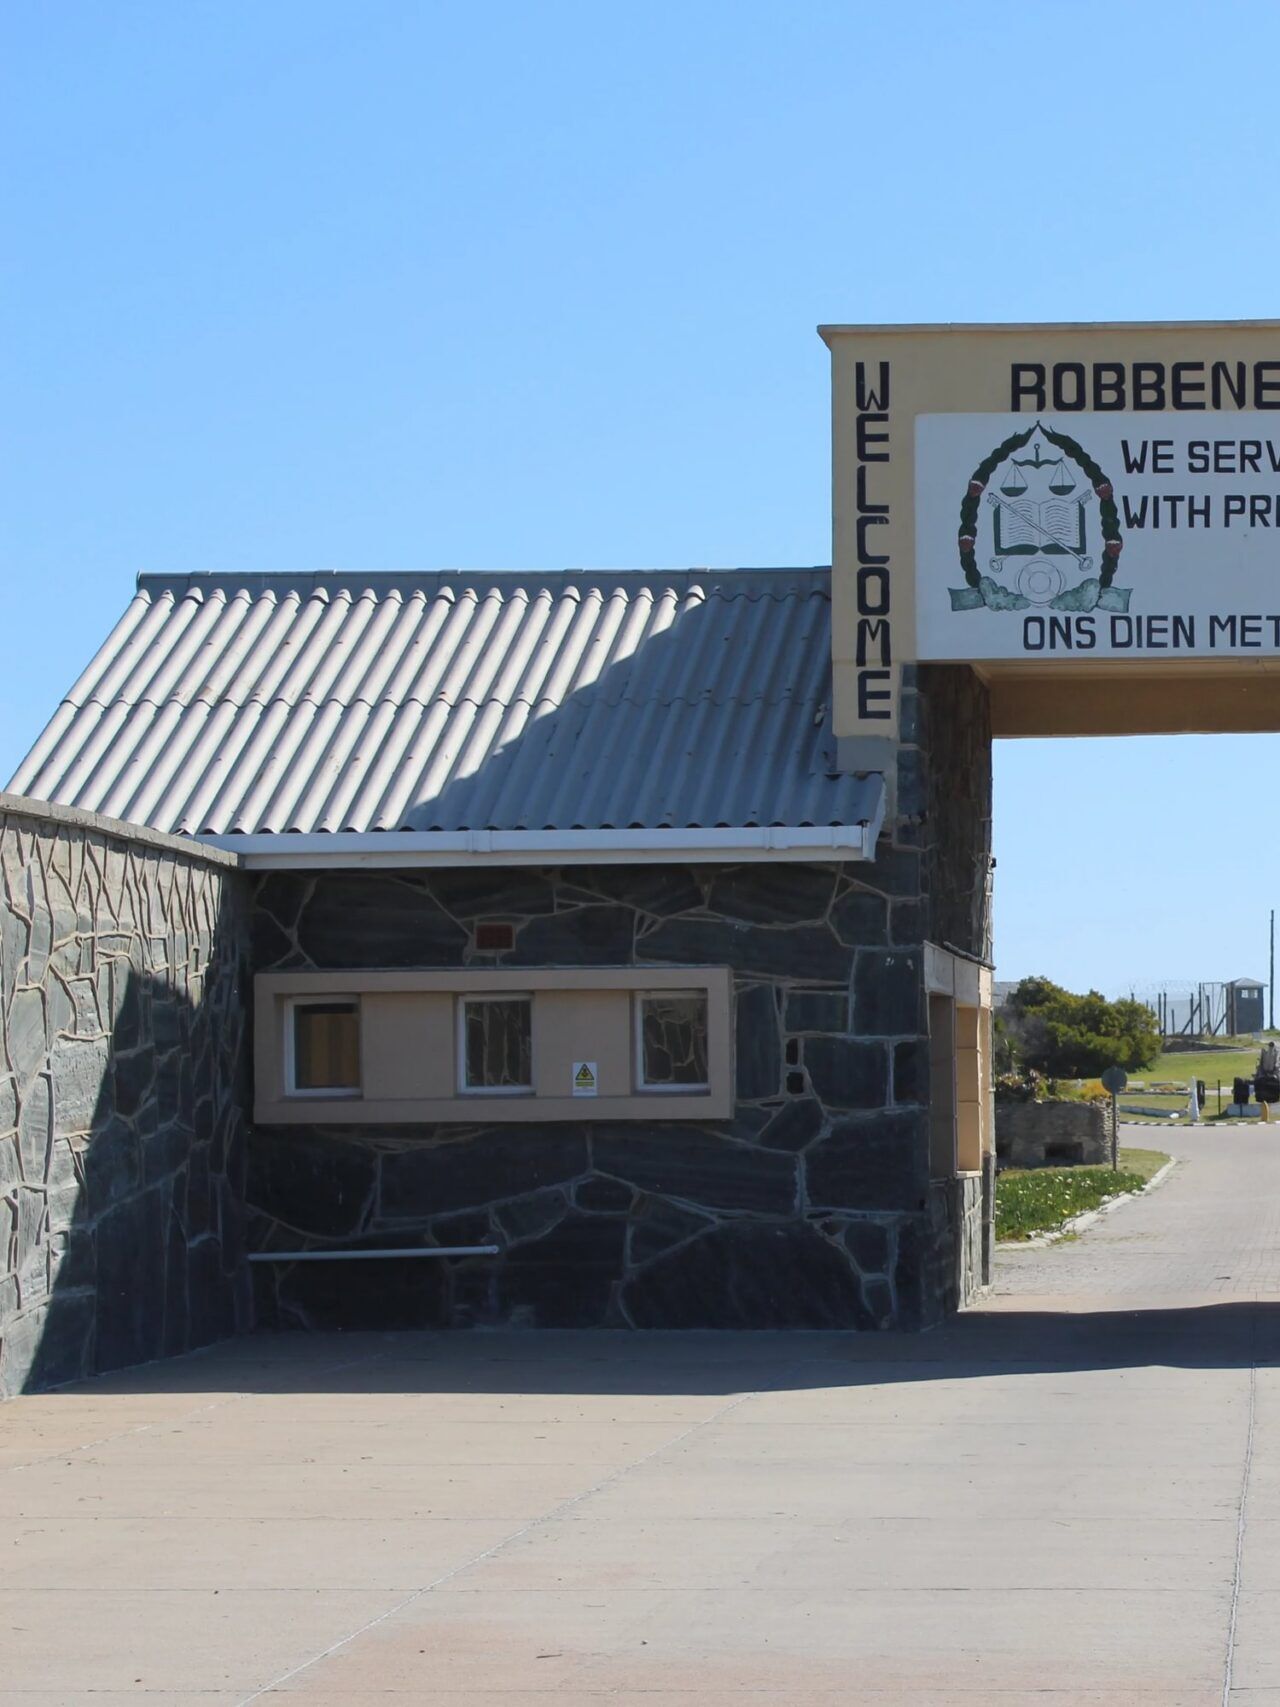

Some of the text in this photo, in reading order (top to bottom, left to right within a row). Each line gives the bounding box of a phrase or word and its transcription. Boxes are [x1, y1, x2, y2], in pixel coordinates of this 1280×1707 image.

[1121, 439, 1174, 474] WE
[1122, 495, 1211, 529] WITH
[855, 361, 891, 720] WELCOME
[1023, 615, 1097, 650] ONS
[1110, 615, 1195, 648] DIEN
